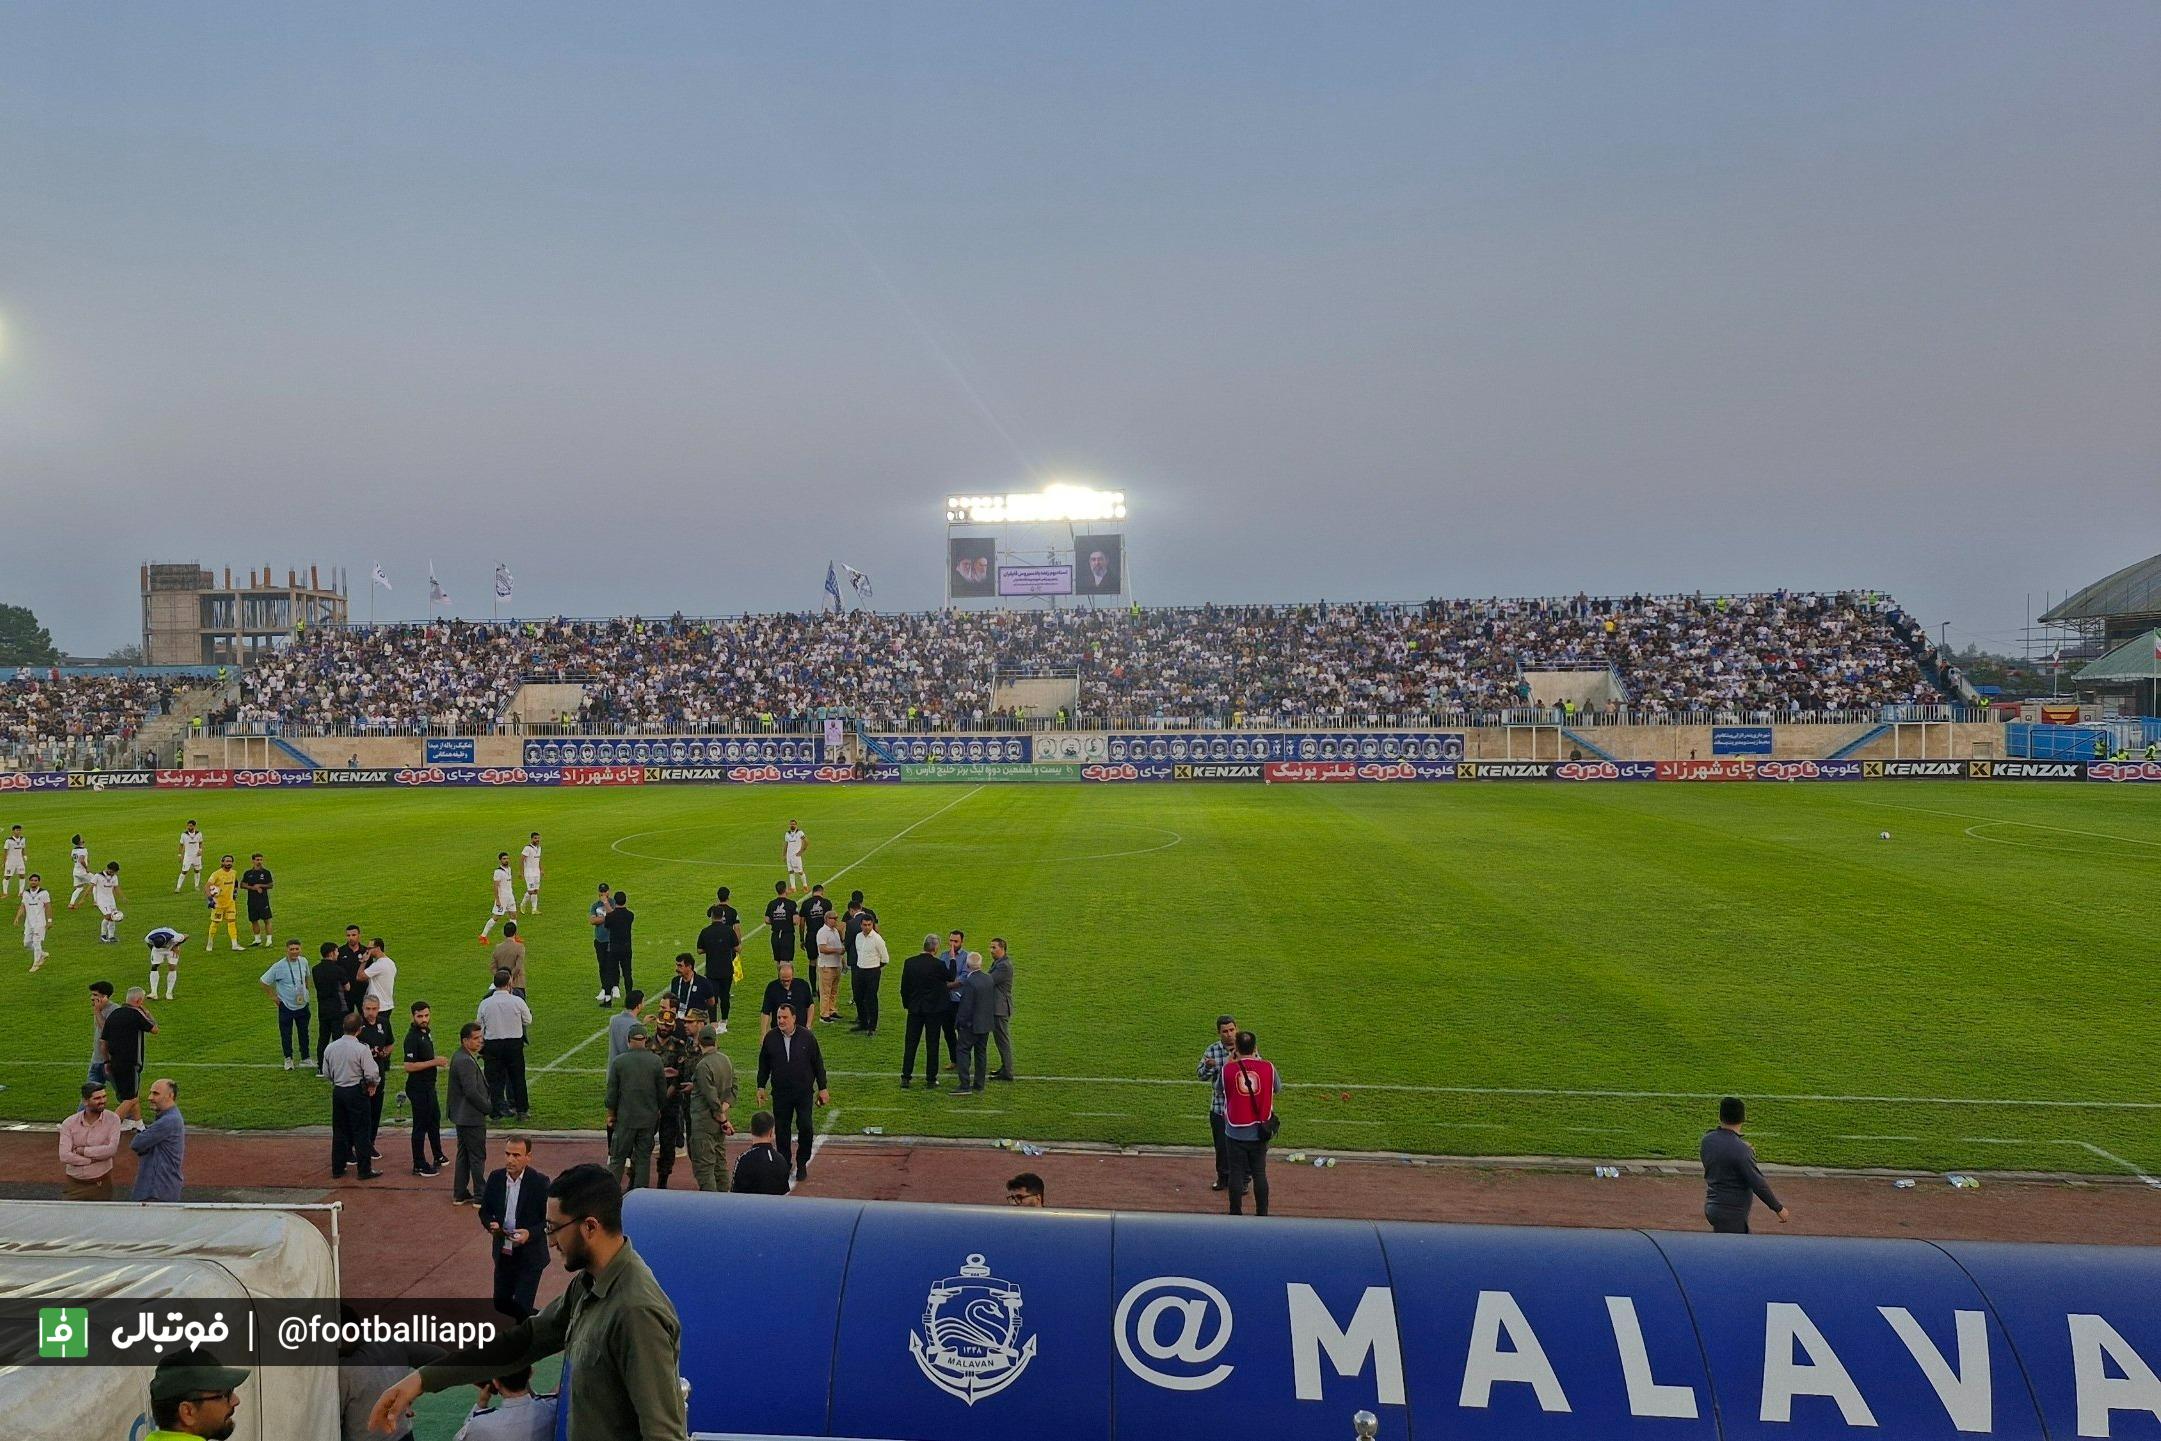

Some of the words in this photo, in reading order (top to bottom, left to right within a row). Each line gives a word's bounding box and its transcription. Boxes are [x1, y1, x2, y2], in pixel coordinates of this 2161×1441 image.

[661, 769, 721, 780] KENZAX
[783, 768, 812, 781] چای
[916, 765, 935, 776] فارس
[937, 765, 955, 776] خلیج
[956, 766, 968, 777] برتر
[970, 764, 984, 775] لیگ
[1002, 764, 1032, 776] ششمین
[1040, 765, 1062, 776] بیست
[1140, 766, 1170, 779] چای
[1193, 766, 1260, 777] KENZAX
[1272, 764, 1316, 778] یونیک
[1322, 765, 1355, 780] فیلتر
[1418, 766, 1454, 778] کلوچه
[1477, 765, 1549, 777] KENZAX
[1621, 764, 1656, 777] چای
[1661, 760, 1723, 779] شهرزاد
[1727, 761, 1756, 779] چای
[1821, 764, 1860, 777] کلوچه
[1884, 762, 1961, 775] KENZAX
[1993, 764, 2079, 777] KENZAX
[0, 773, 31, 789] ناد
[33, 775, 65, 786] چای
[86, 773, 149, 785] KENZAX
[156, 771, 196, 786] یونیک
[200, 771, 228, 787] فیلتر
[282, 772, 312, 784] کلوچه
[329, 771, 388, 782] KENZAX
[447, 770, 476, 783] چای
[529, 770, 561, 783] کلوچه
[563, 767, 613, 784] شهرزاد
[616, 768, 640, 783] چای
[947, 1357, 994, 1368] MALAVAN
